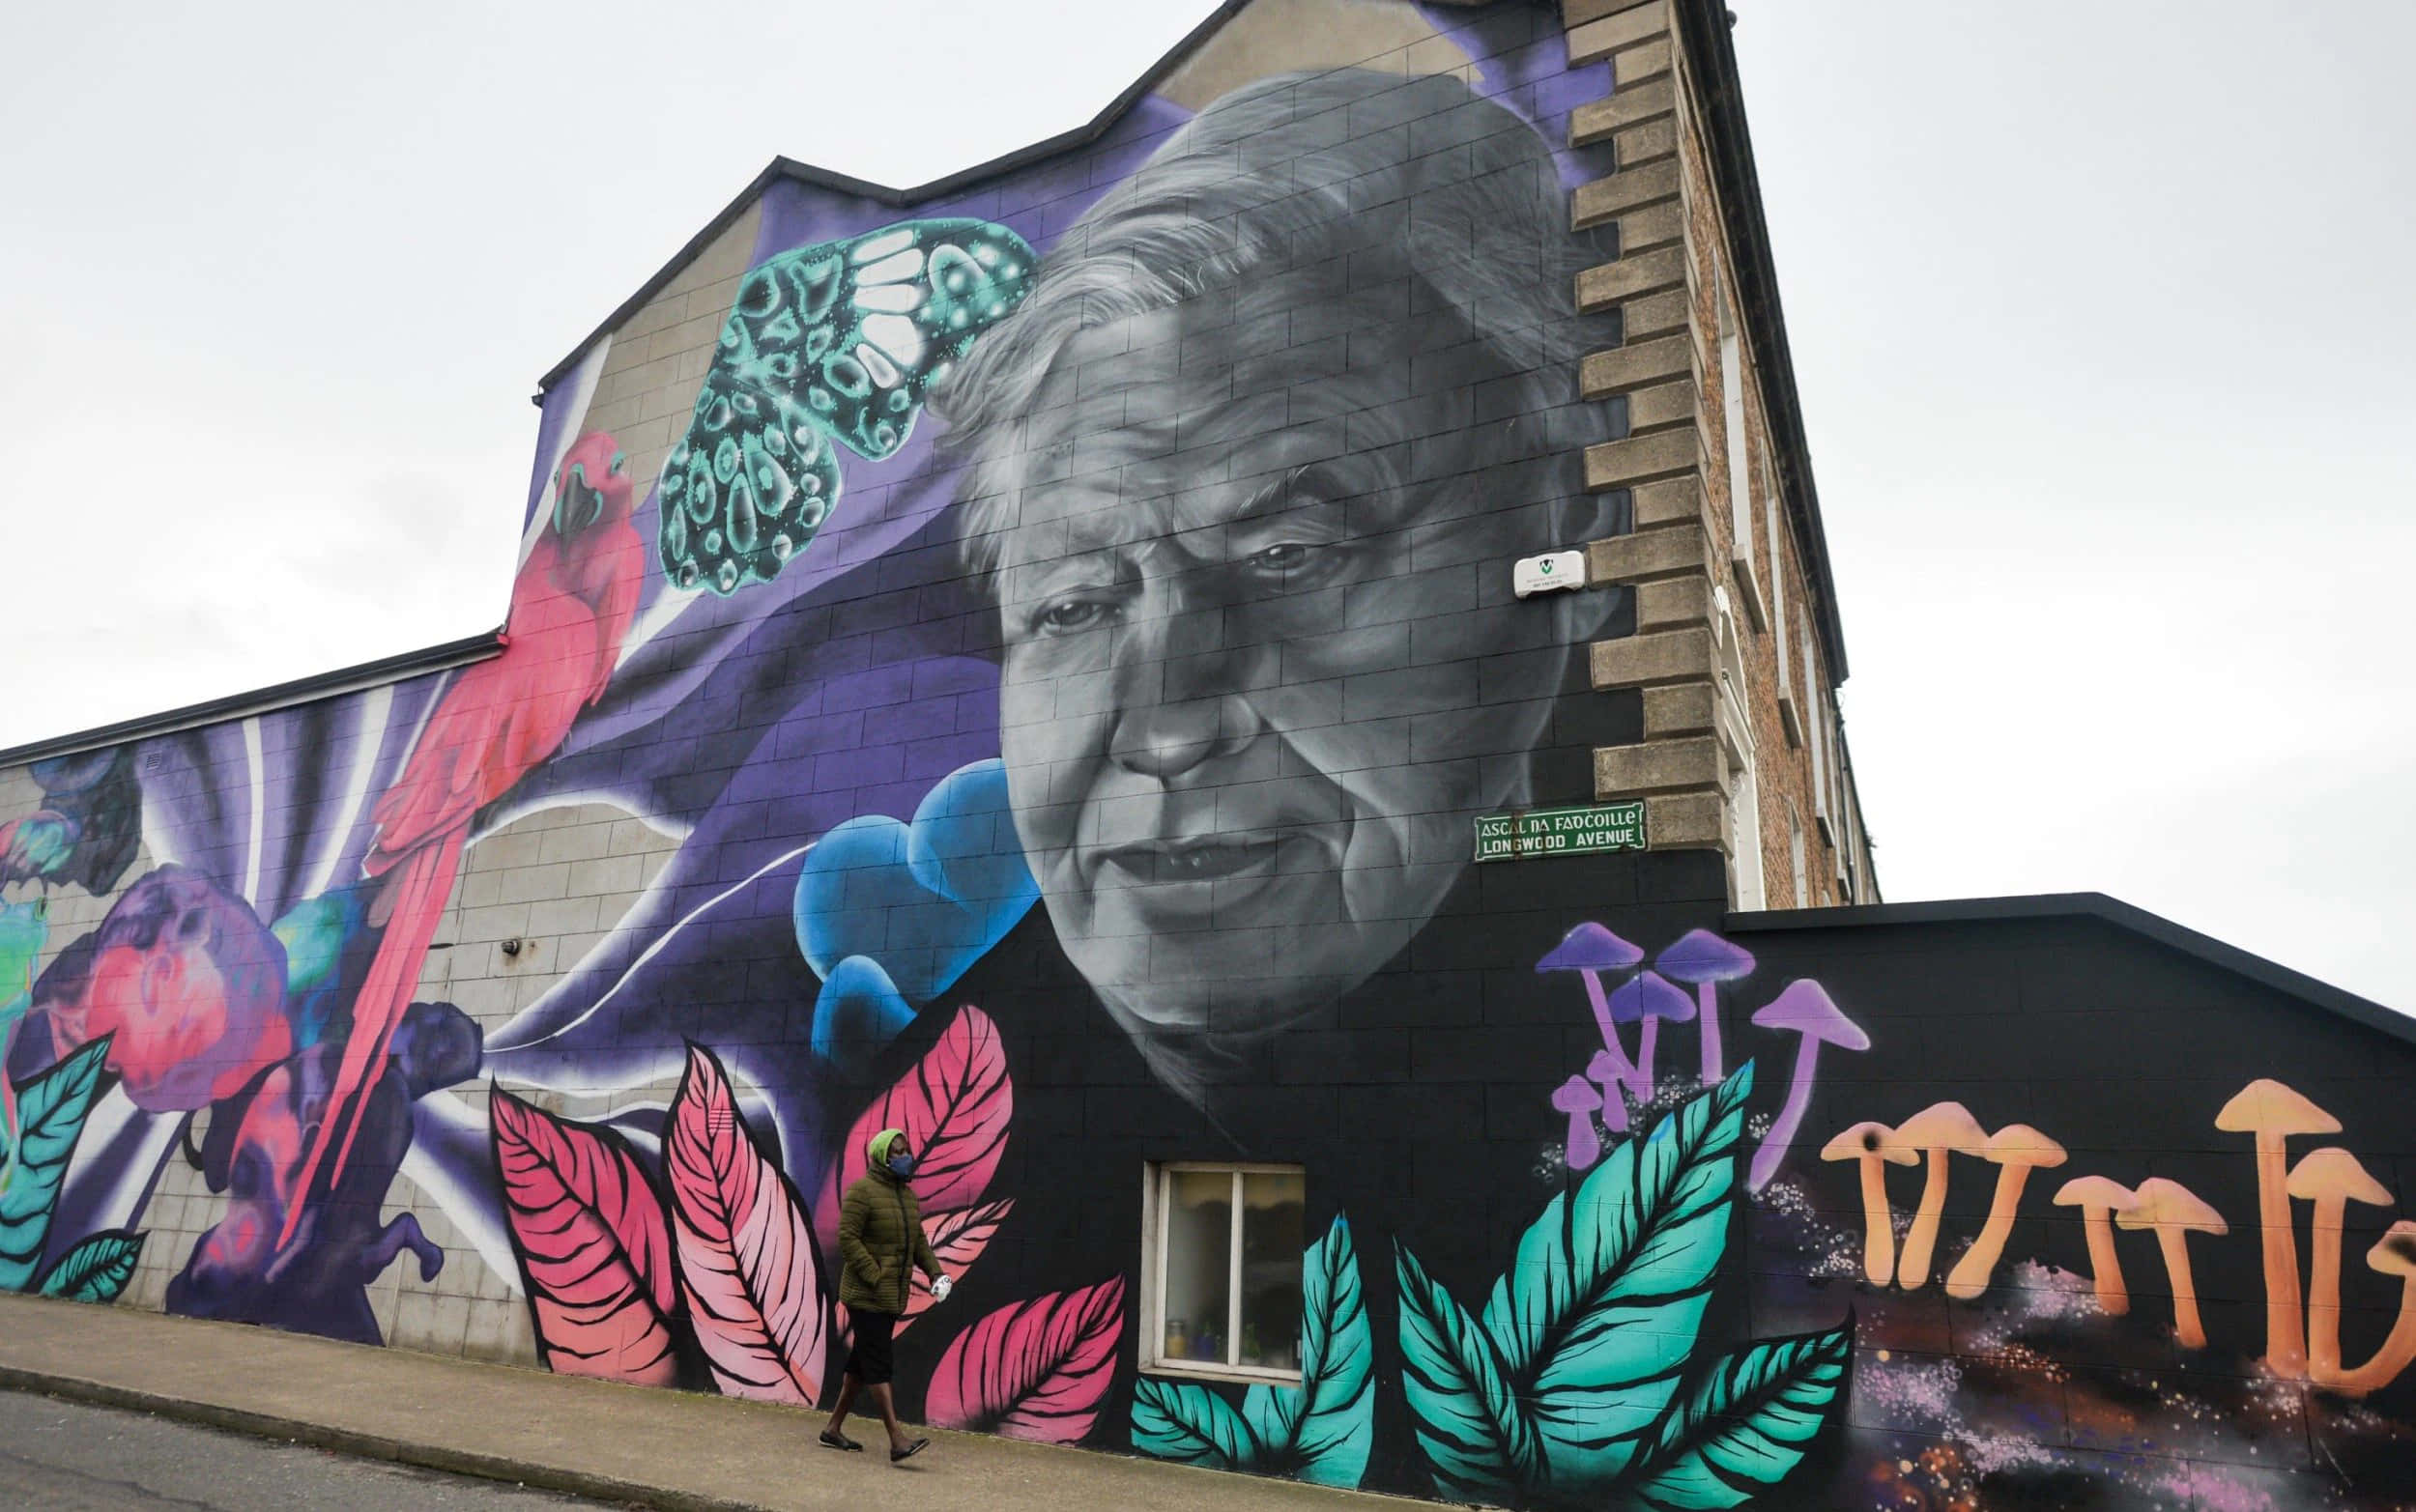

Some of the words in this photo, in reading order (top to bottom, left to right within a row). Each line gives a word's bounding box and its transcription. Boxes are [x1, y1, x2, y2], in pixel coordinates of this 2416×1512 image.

[1481, 821, 1527, 837] ASCAL
[1531, 818, 1550, 833] NA
[1483, 835, 1566, 854] LONGWOOD
[1576, 828, 1635, 846] AVENUE
